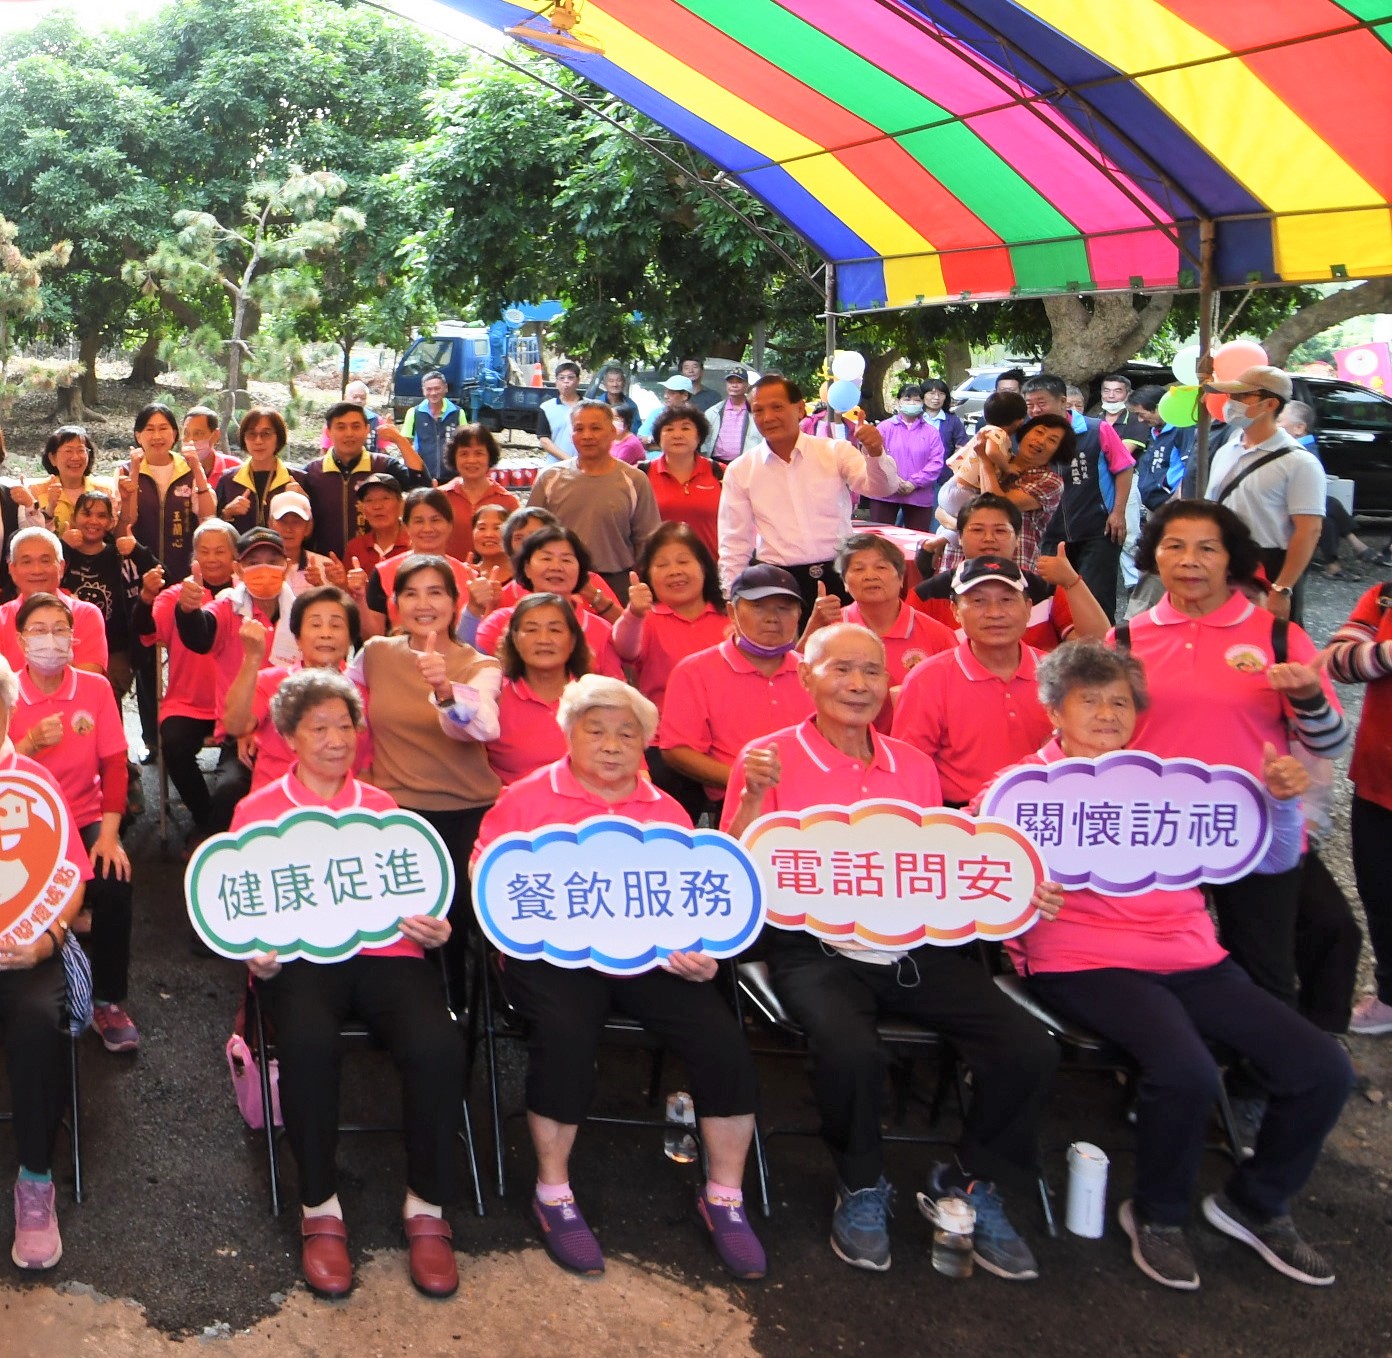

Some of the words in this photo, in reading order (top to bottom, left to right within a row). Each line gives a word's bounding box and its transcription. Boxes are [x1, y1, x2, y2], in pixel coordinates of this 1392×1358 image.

[1015, 801, 1240, 848] 關懷訪視
[218, 848, 426, 921] 健康促進
[507, 870, 732, 921] 餐飲服務
[770, 849, 1013, 901] 電話問安
